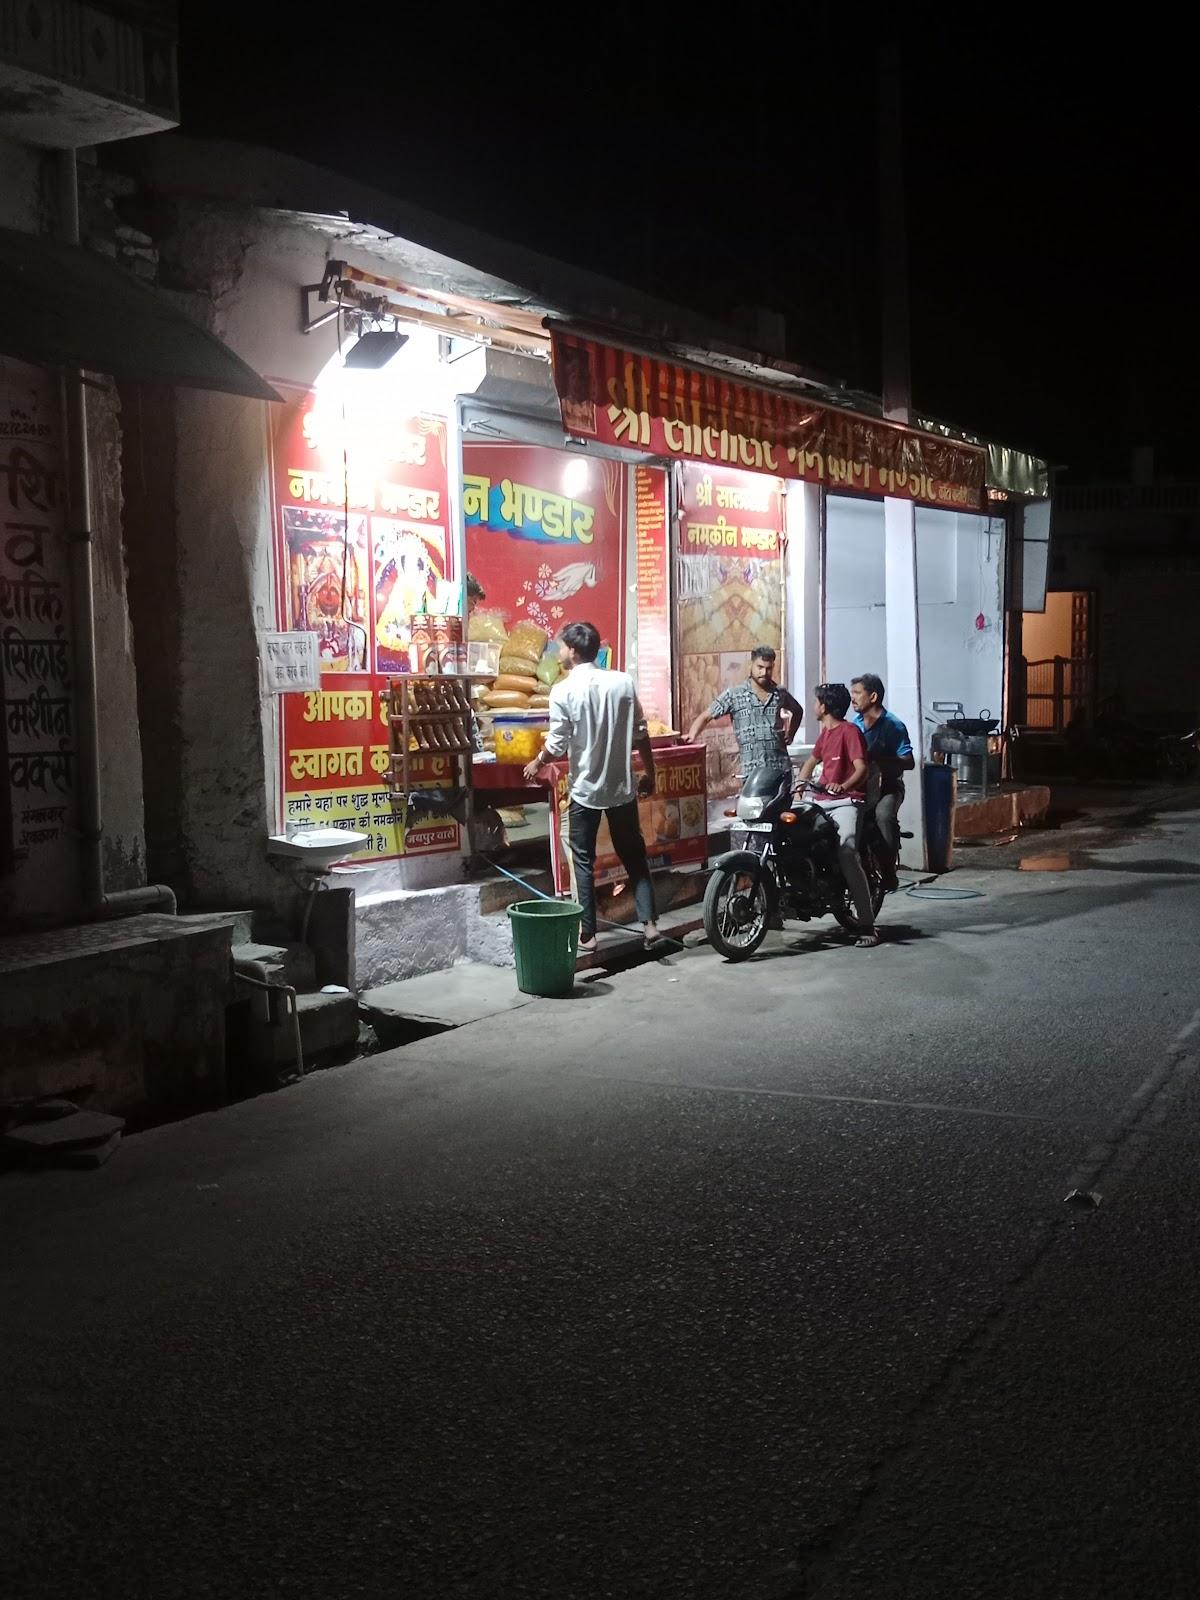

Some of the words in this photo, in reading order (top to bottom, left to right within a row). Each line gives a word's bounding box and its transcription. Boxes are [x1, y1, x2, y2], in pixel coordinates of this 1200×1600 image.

[695, 475, 713, 507] श्री
[500, 478, 595, 545] भण्डार
[687, 516, 738, 548] नमकीन
[5, 685, 72, 739] मशीन
[303, 688, 373, 722] आपका
[289, 746, 364, 780] स्वागत
[669, 764, 702, 791] भण्डार
[288, 793, 311, 815] हमारे
[336, 795, 348, 808] पर
[351, 793, 368, 811] शुद्ध
[359, 811, 370, 829] की
